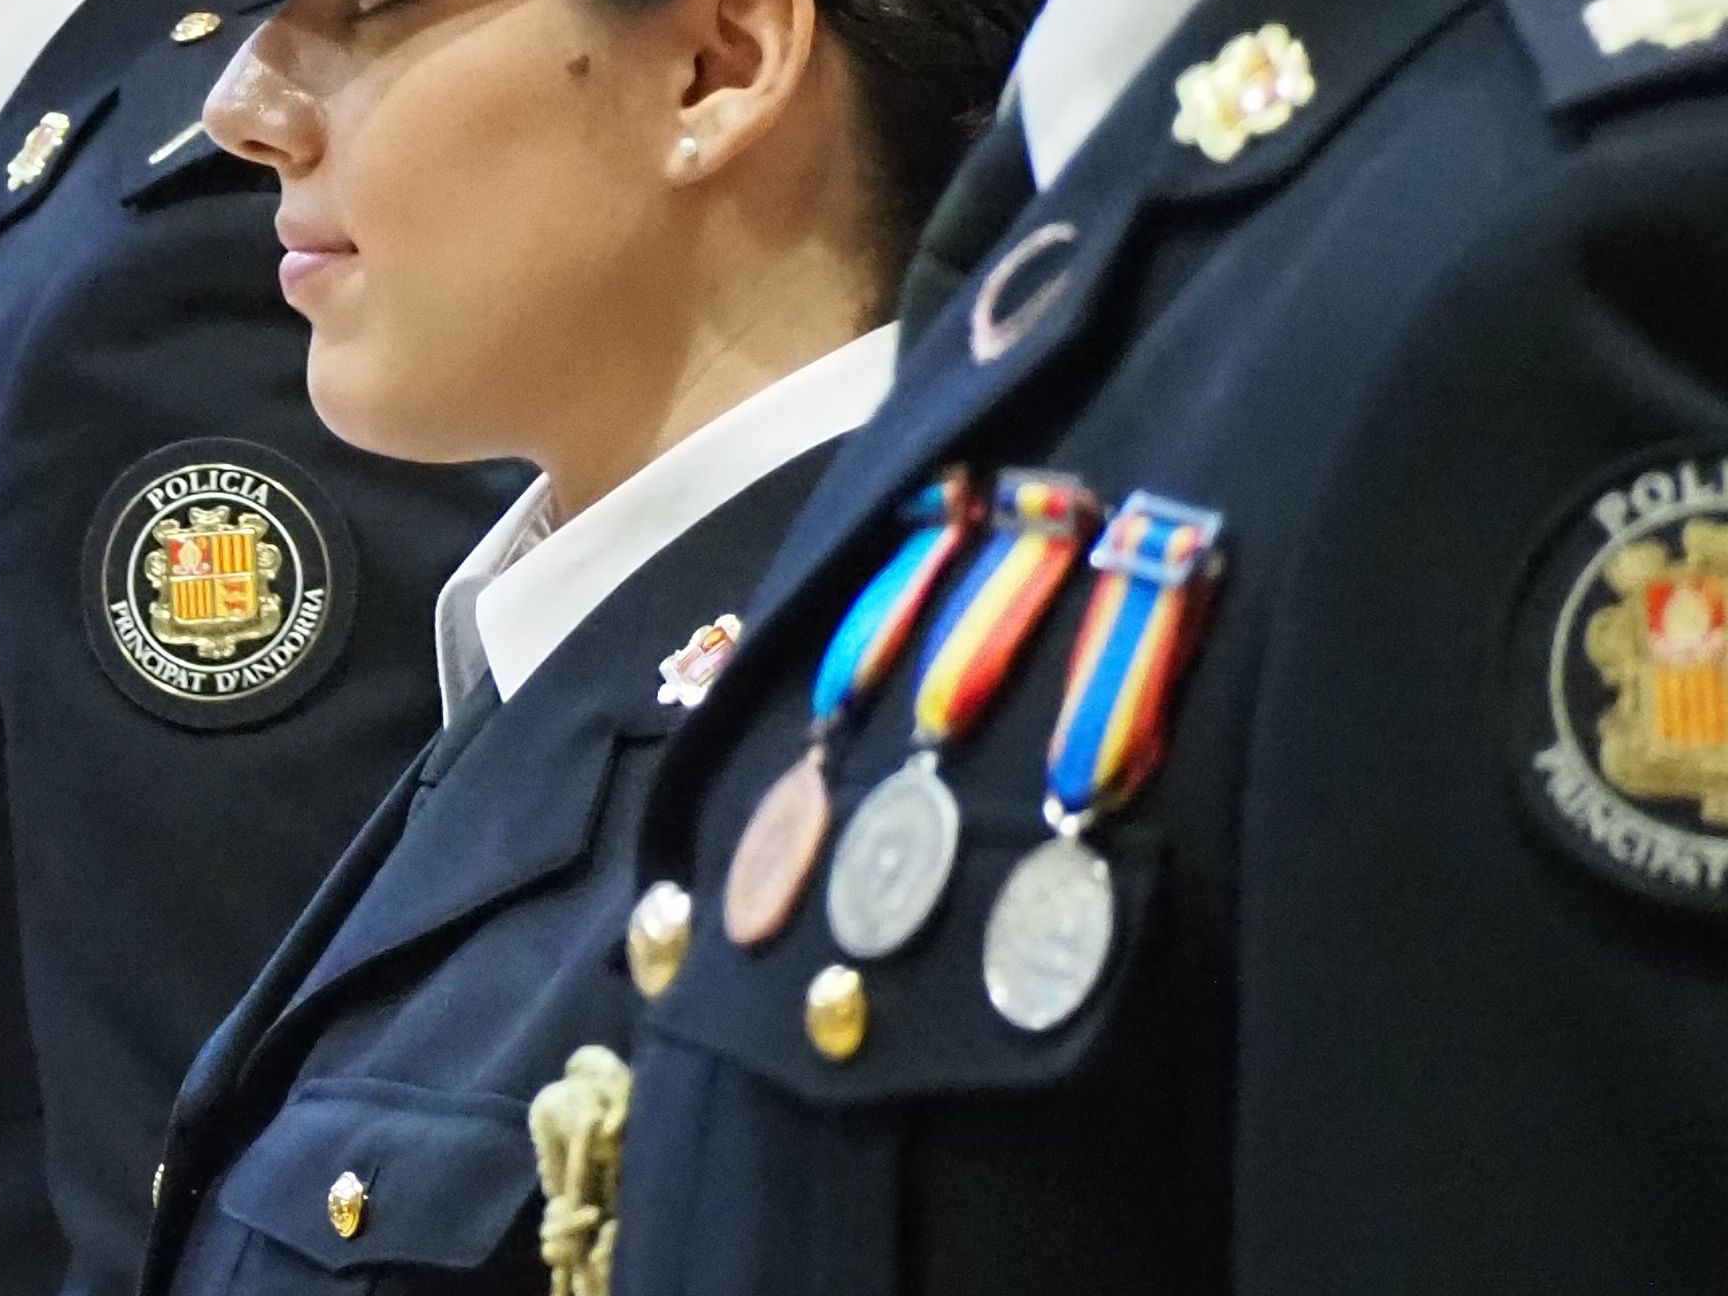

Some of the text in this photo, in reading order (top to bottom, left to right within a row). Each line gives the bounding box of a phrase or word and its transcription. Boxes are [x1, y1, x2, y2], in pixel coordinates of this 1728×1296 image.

[146, 470, 269, 511] POLICIA
[111, 588, 325, 693] PRINCIPAT D'ANDORRA
